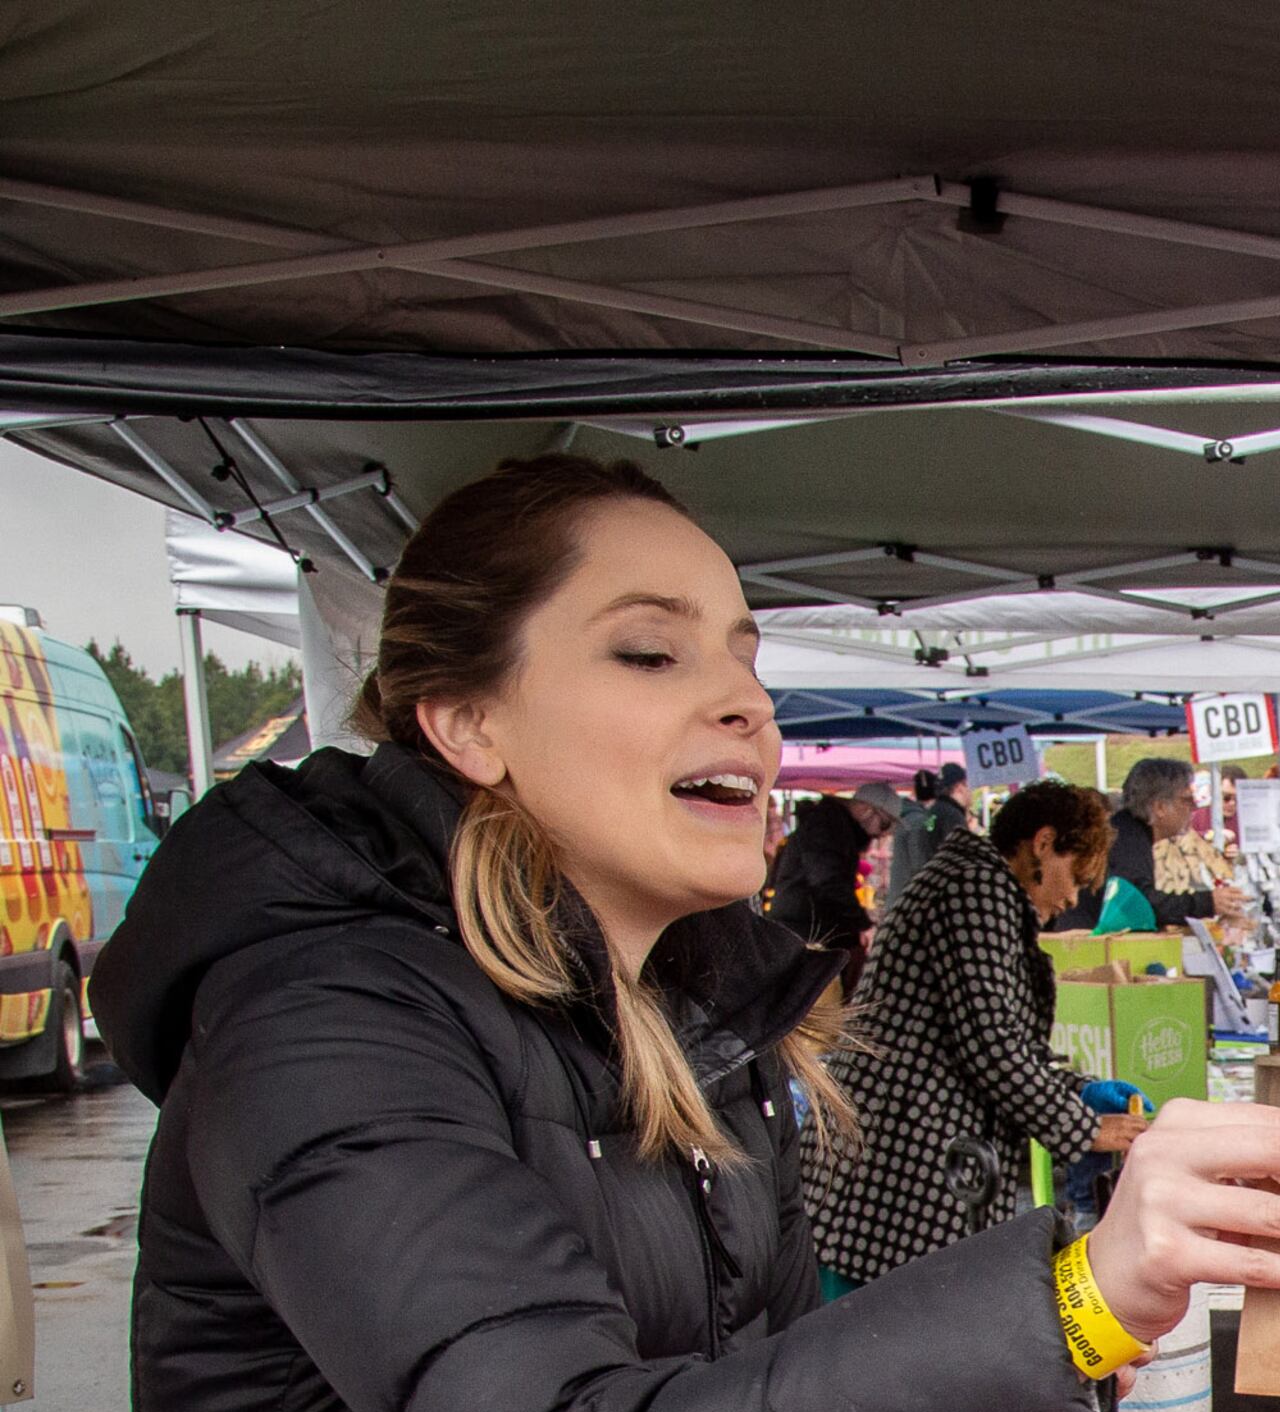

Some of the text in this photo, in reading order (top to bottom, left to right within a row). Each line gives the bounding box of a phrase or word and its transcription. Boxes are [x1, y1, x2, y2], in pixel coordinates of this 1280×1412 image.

[1204, 702, 1261, 738] CBD
[977, 738, 1024, 769] CBD
[1142, 1027, 1182, 1056] Hello
[1147, 1048, 1184, 1071] FRESH
[1061, 1314, 1104, 1367] George
